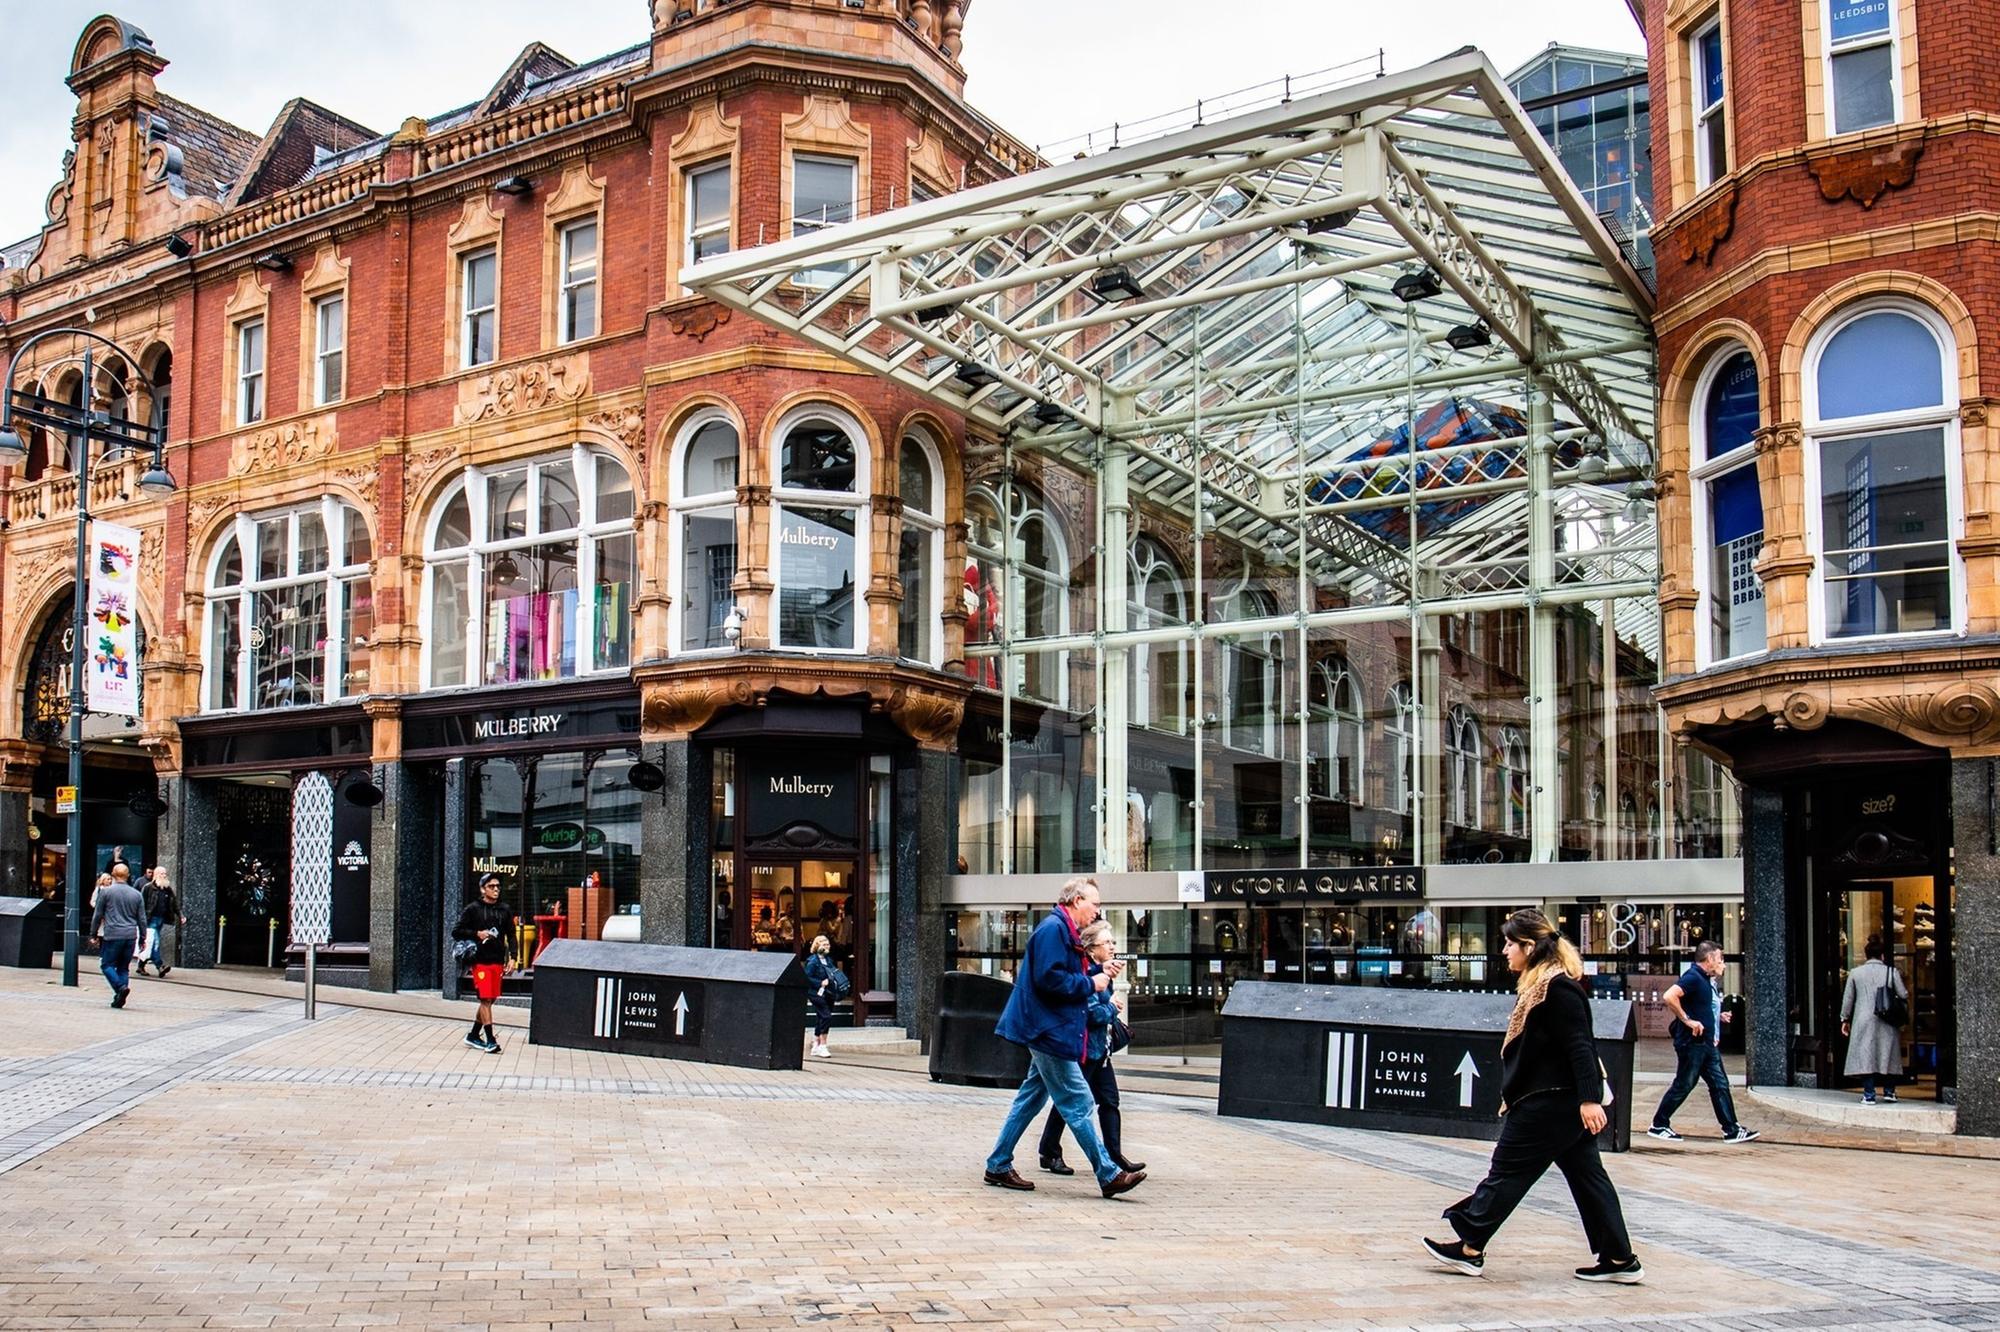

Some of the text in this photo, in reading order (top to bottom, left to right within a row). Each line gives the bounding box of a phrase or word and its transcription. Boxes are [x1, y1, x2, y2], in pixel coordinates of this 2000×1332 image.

[1834, 3, 1885, 21] LEEDSBID
[778, 526, 839, 550] Mulberry
[475, 714, 562, 738] MULBERRY
[770, 775, 834, 798] Mulberry
[1862, 794, 1896, 815] size?
[337, 856, 369, 866] VICTORIA
[473, 856, 519, 877] Mulberry
[1315, 875, 1417, 894] QUARTER
[628, 992, 656, 1002] JOHN
[624, 1006, 657, 1017] LEWIS
[629, 1020, 656, 1028] PARTNERS
[1379, 1050, 1424, 1064] JOHN
[1375, 1069, 1428, 1083] LEWIS
[1382, 1088, 1425, 1097] PARTNERS
